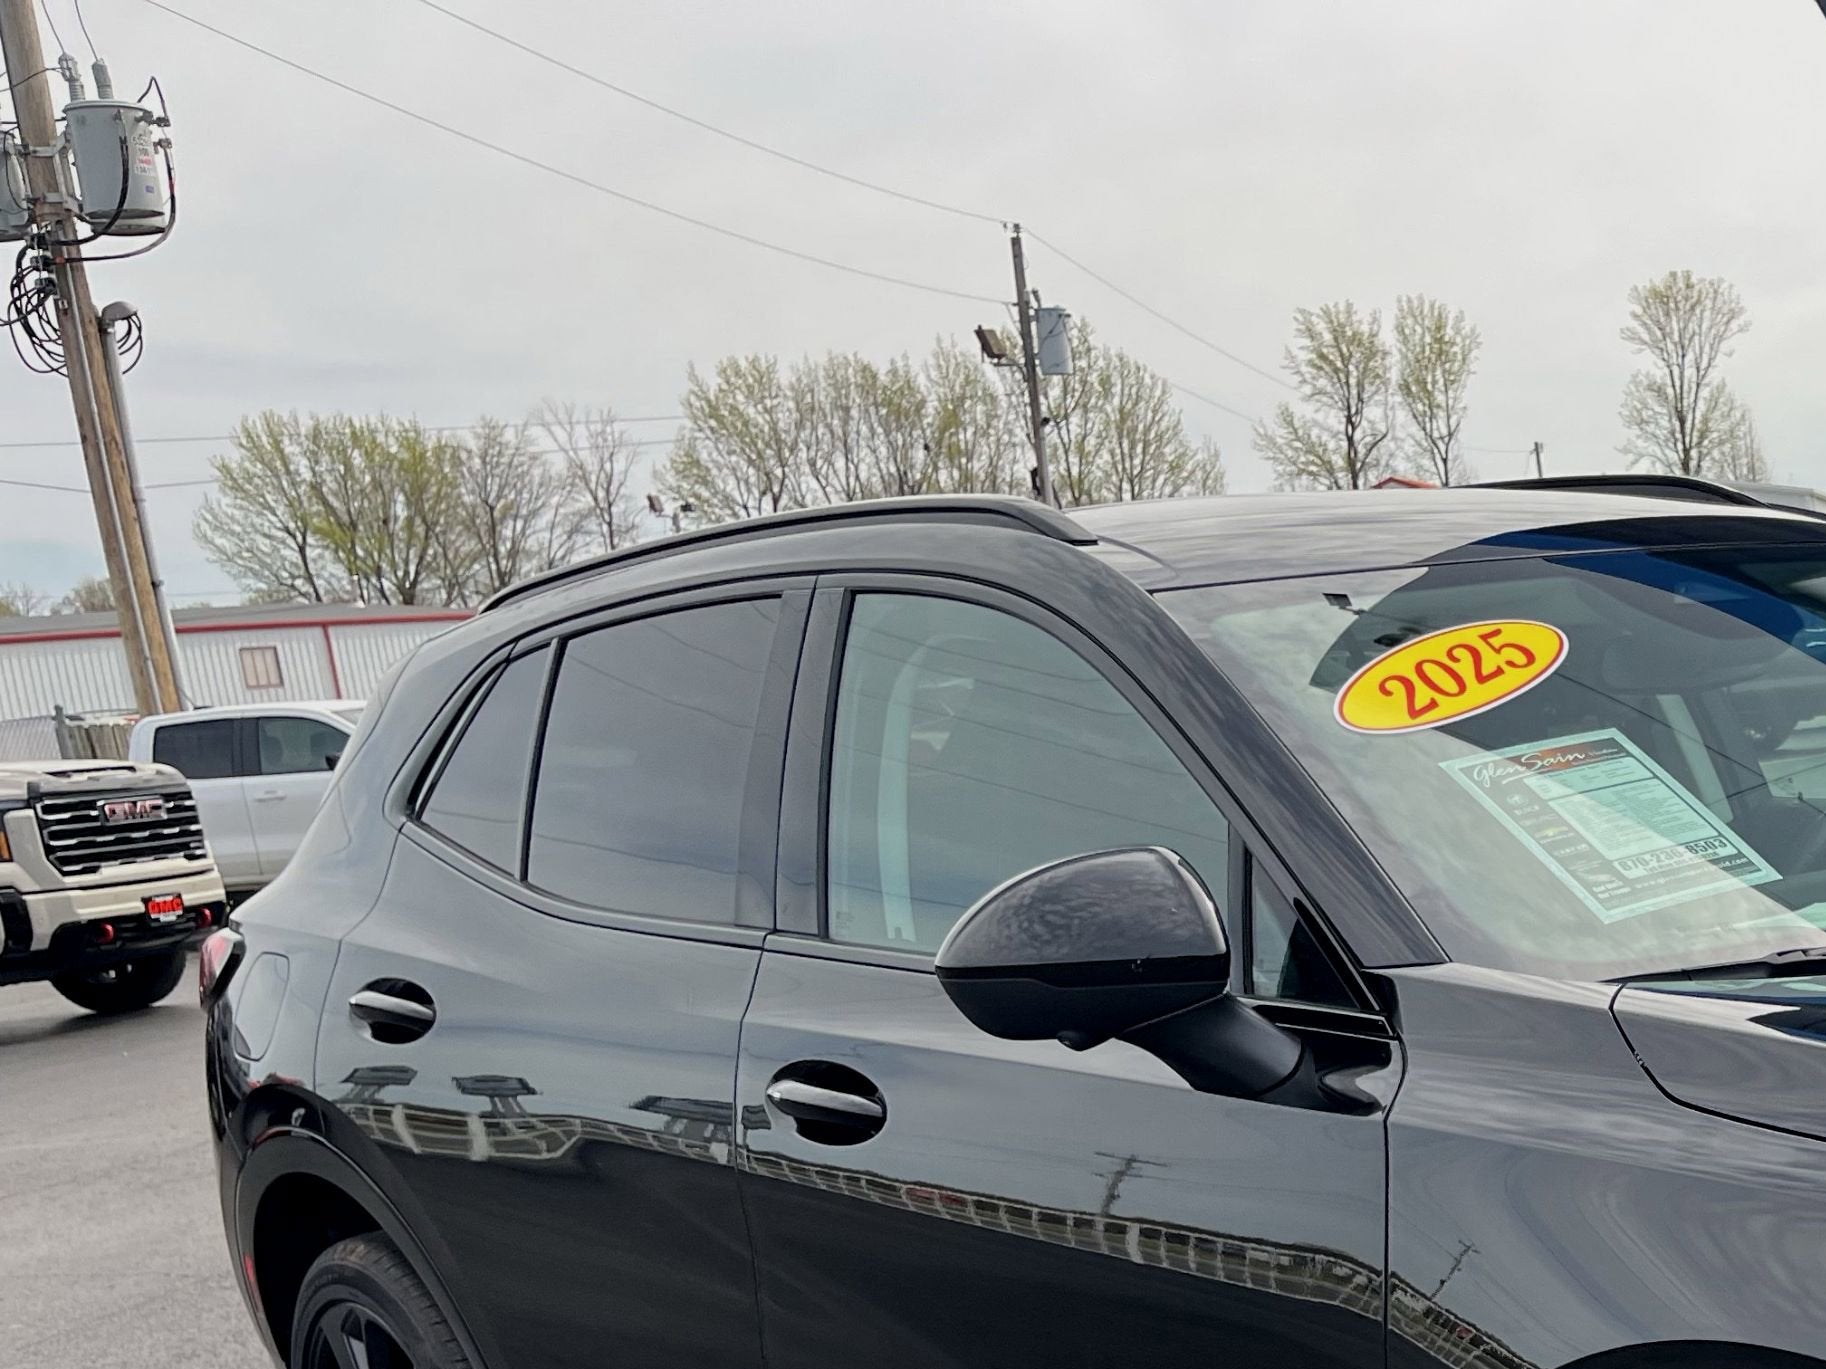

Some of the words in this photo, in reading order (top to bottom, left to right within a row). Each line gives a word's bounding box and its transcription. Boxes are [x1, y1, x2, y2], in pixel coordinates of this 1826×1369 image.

[1378, 627, 1537, 720] 2025
[1473, 762, 1526, 788] Glen
[1520, 752, 1585, 771] Sain
